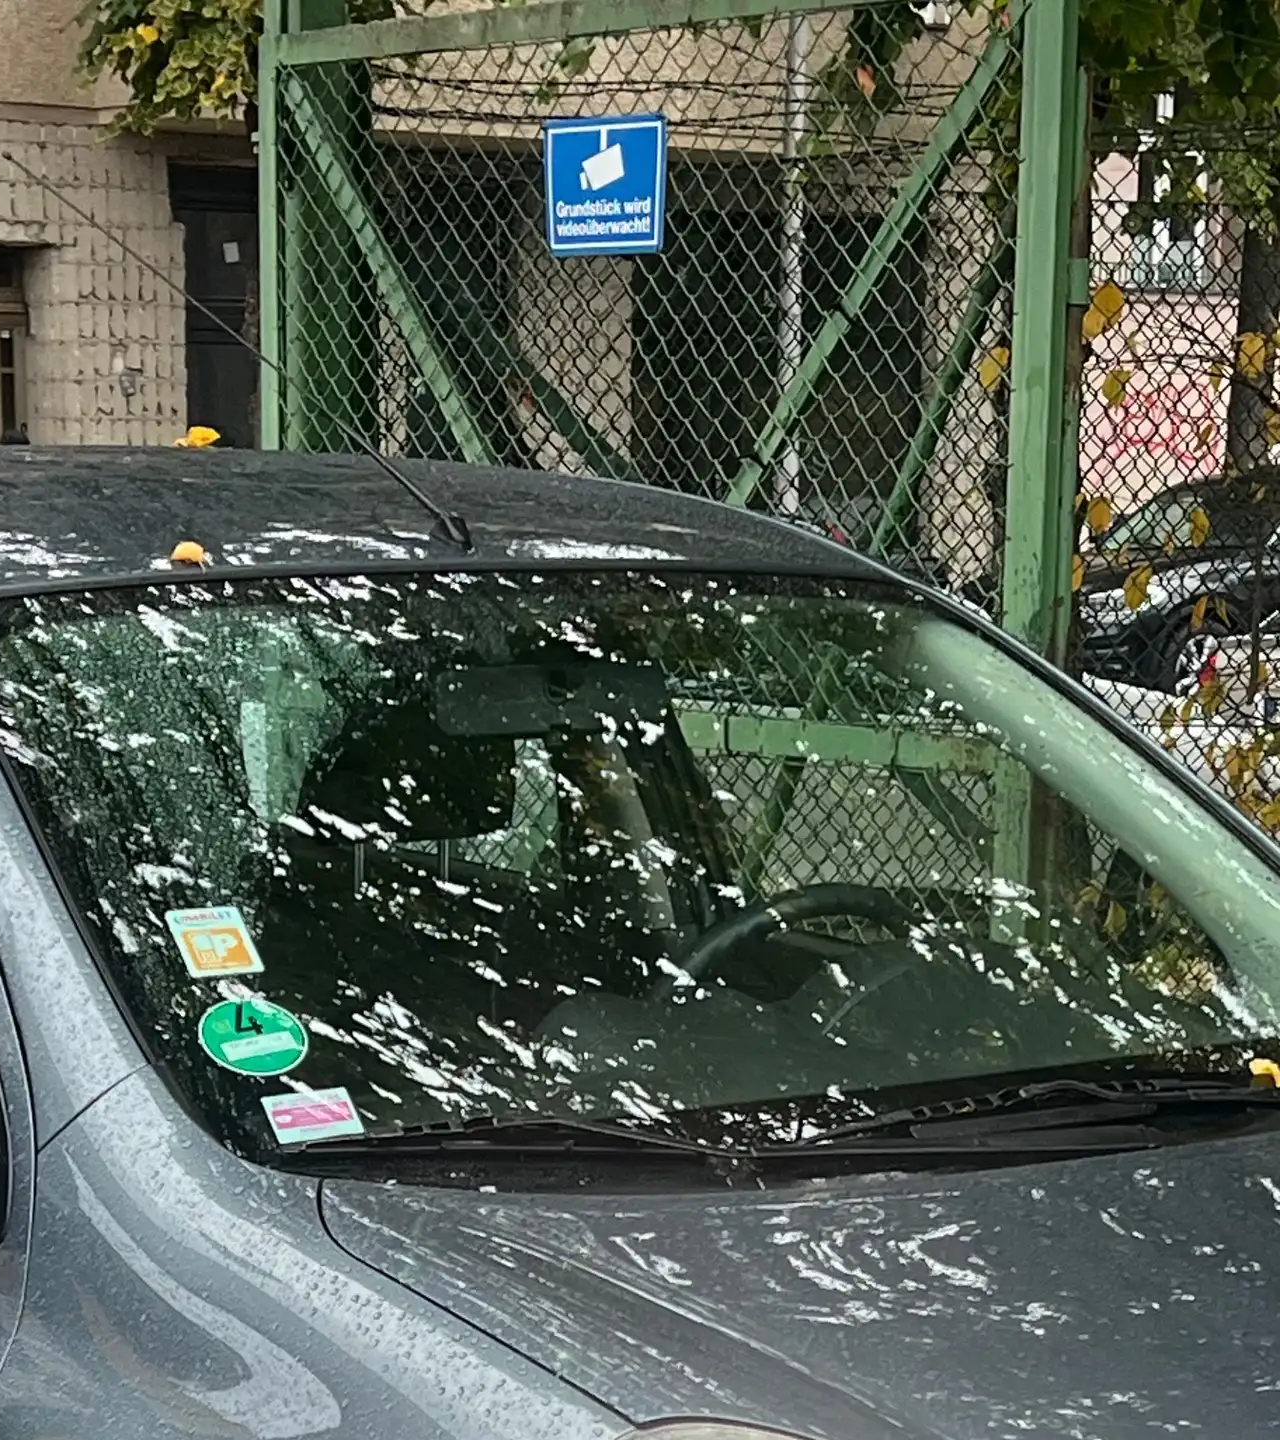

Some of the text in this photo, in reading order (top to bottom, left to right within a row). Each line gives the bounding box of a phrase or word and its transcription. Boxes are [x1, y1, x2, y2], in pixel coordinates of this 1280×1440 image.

[556, 196, 652, 218] Grundstück wird
[556, 216, 651, 236] videoüberwacht!
[233, 1001, 264, 1035] 4
